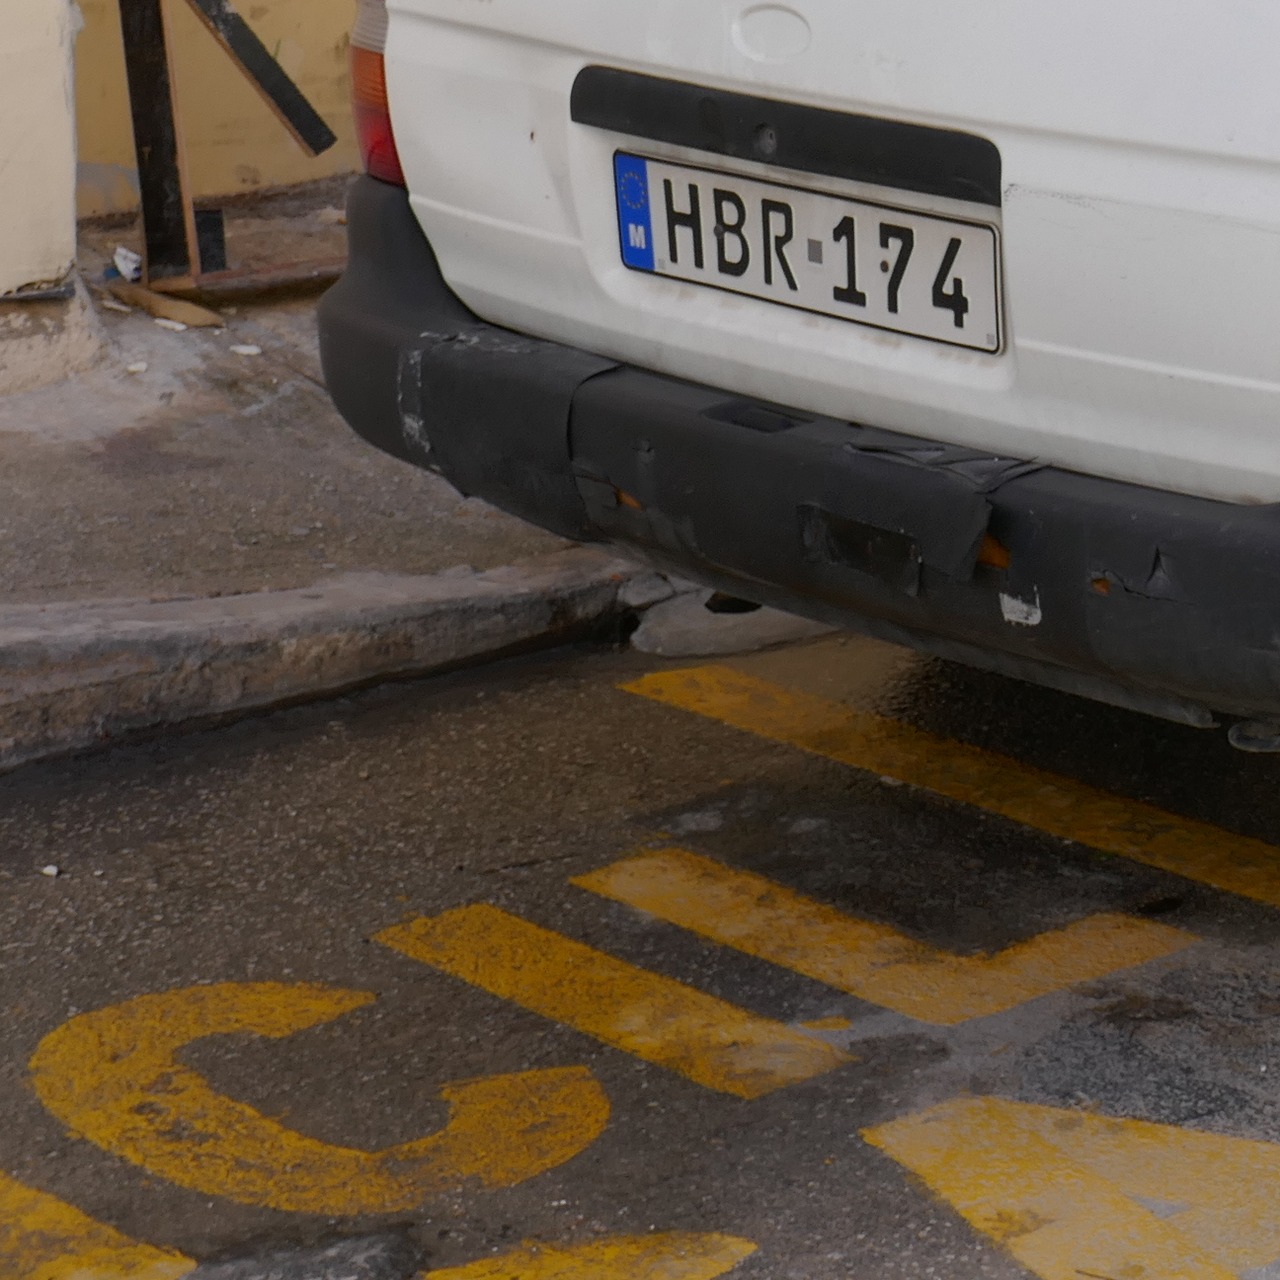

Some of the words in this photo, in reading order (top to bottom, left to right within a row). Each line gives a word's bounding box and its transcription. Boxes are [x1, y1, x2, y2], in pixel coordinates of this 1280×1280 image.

[629, 223, 646, 250] M
[663, 178, 798, 292] HBR
[832, 215, 969, 329] 174
